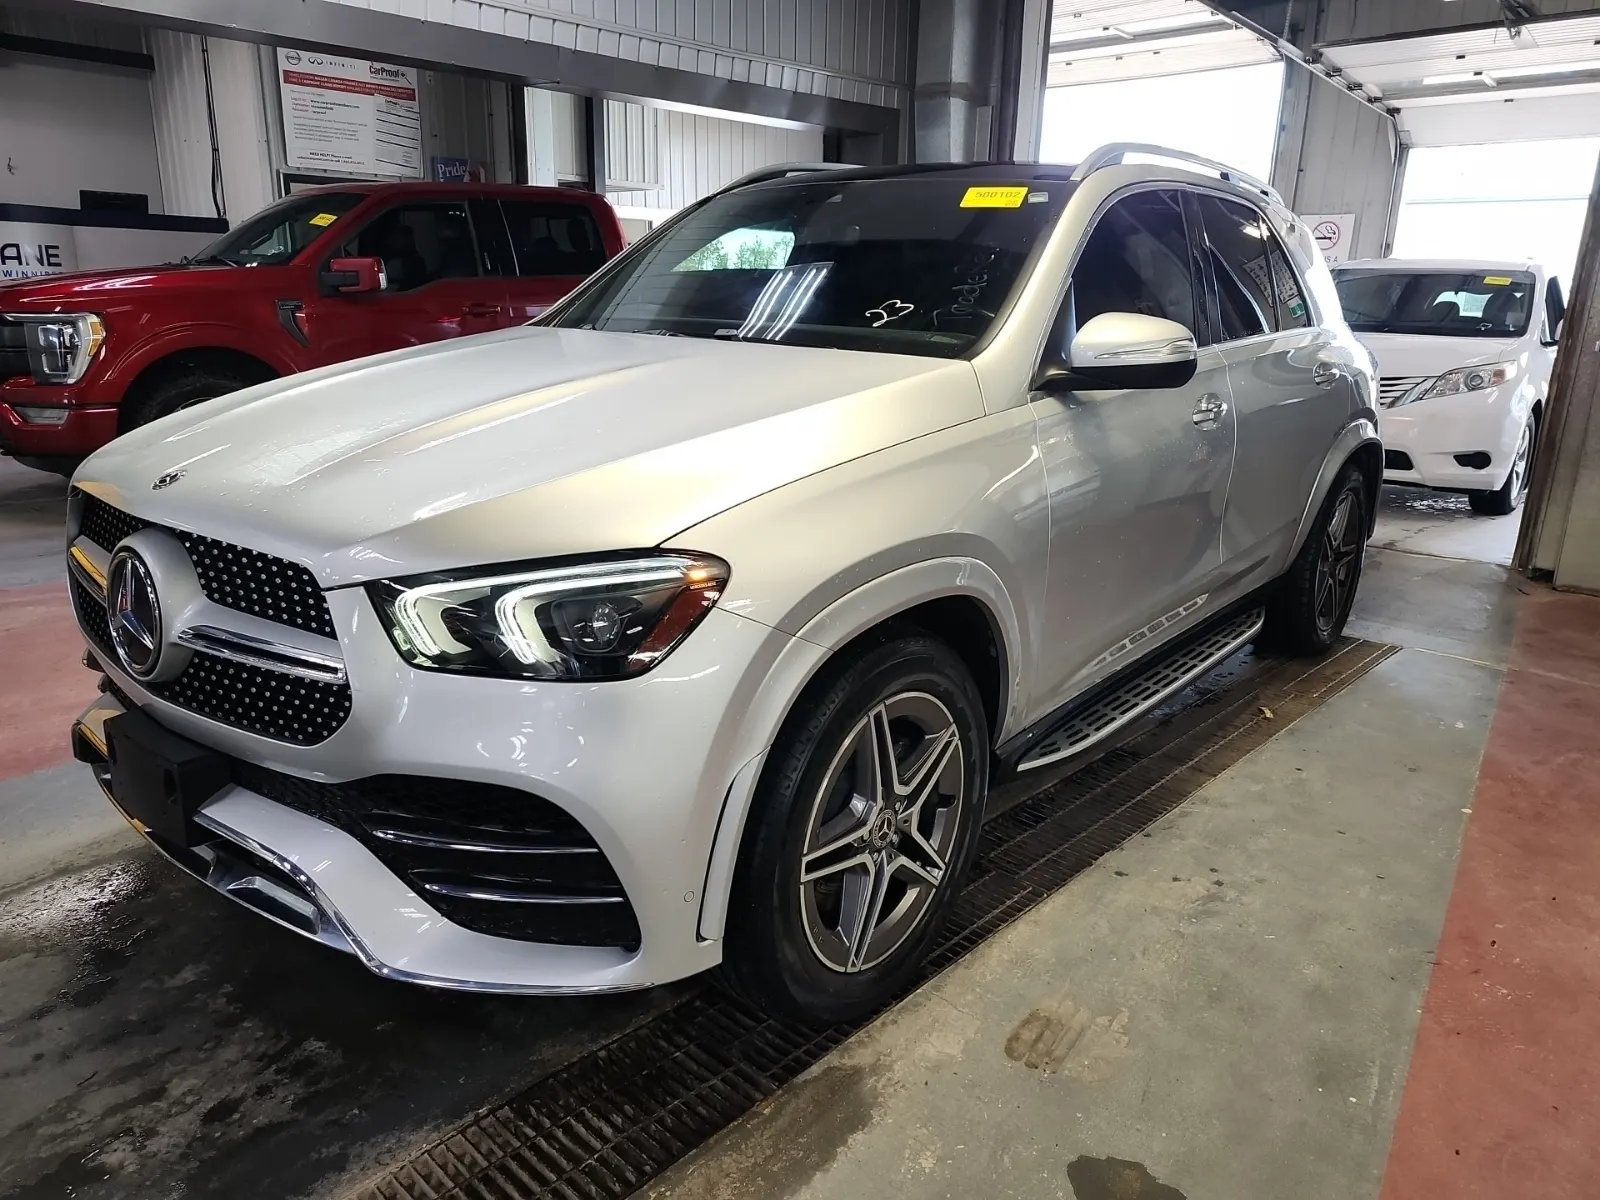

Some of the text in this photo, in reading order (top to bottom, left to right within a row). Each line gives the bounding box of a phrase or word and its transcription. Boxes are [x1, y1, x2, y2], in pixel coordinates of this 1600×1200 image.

[369, 65, 400, 78] CarProof
[437, 162, 466, 178] Pride
[865, 300, 914, 327] 23
